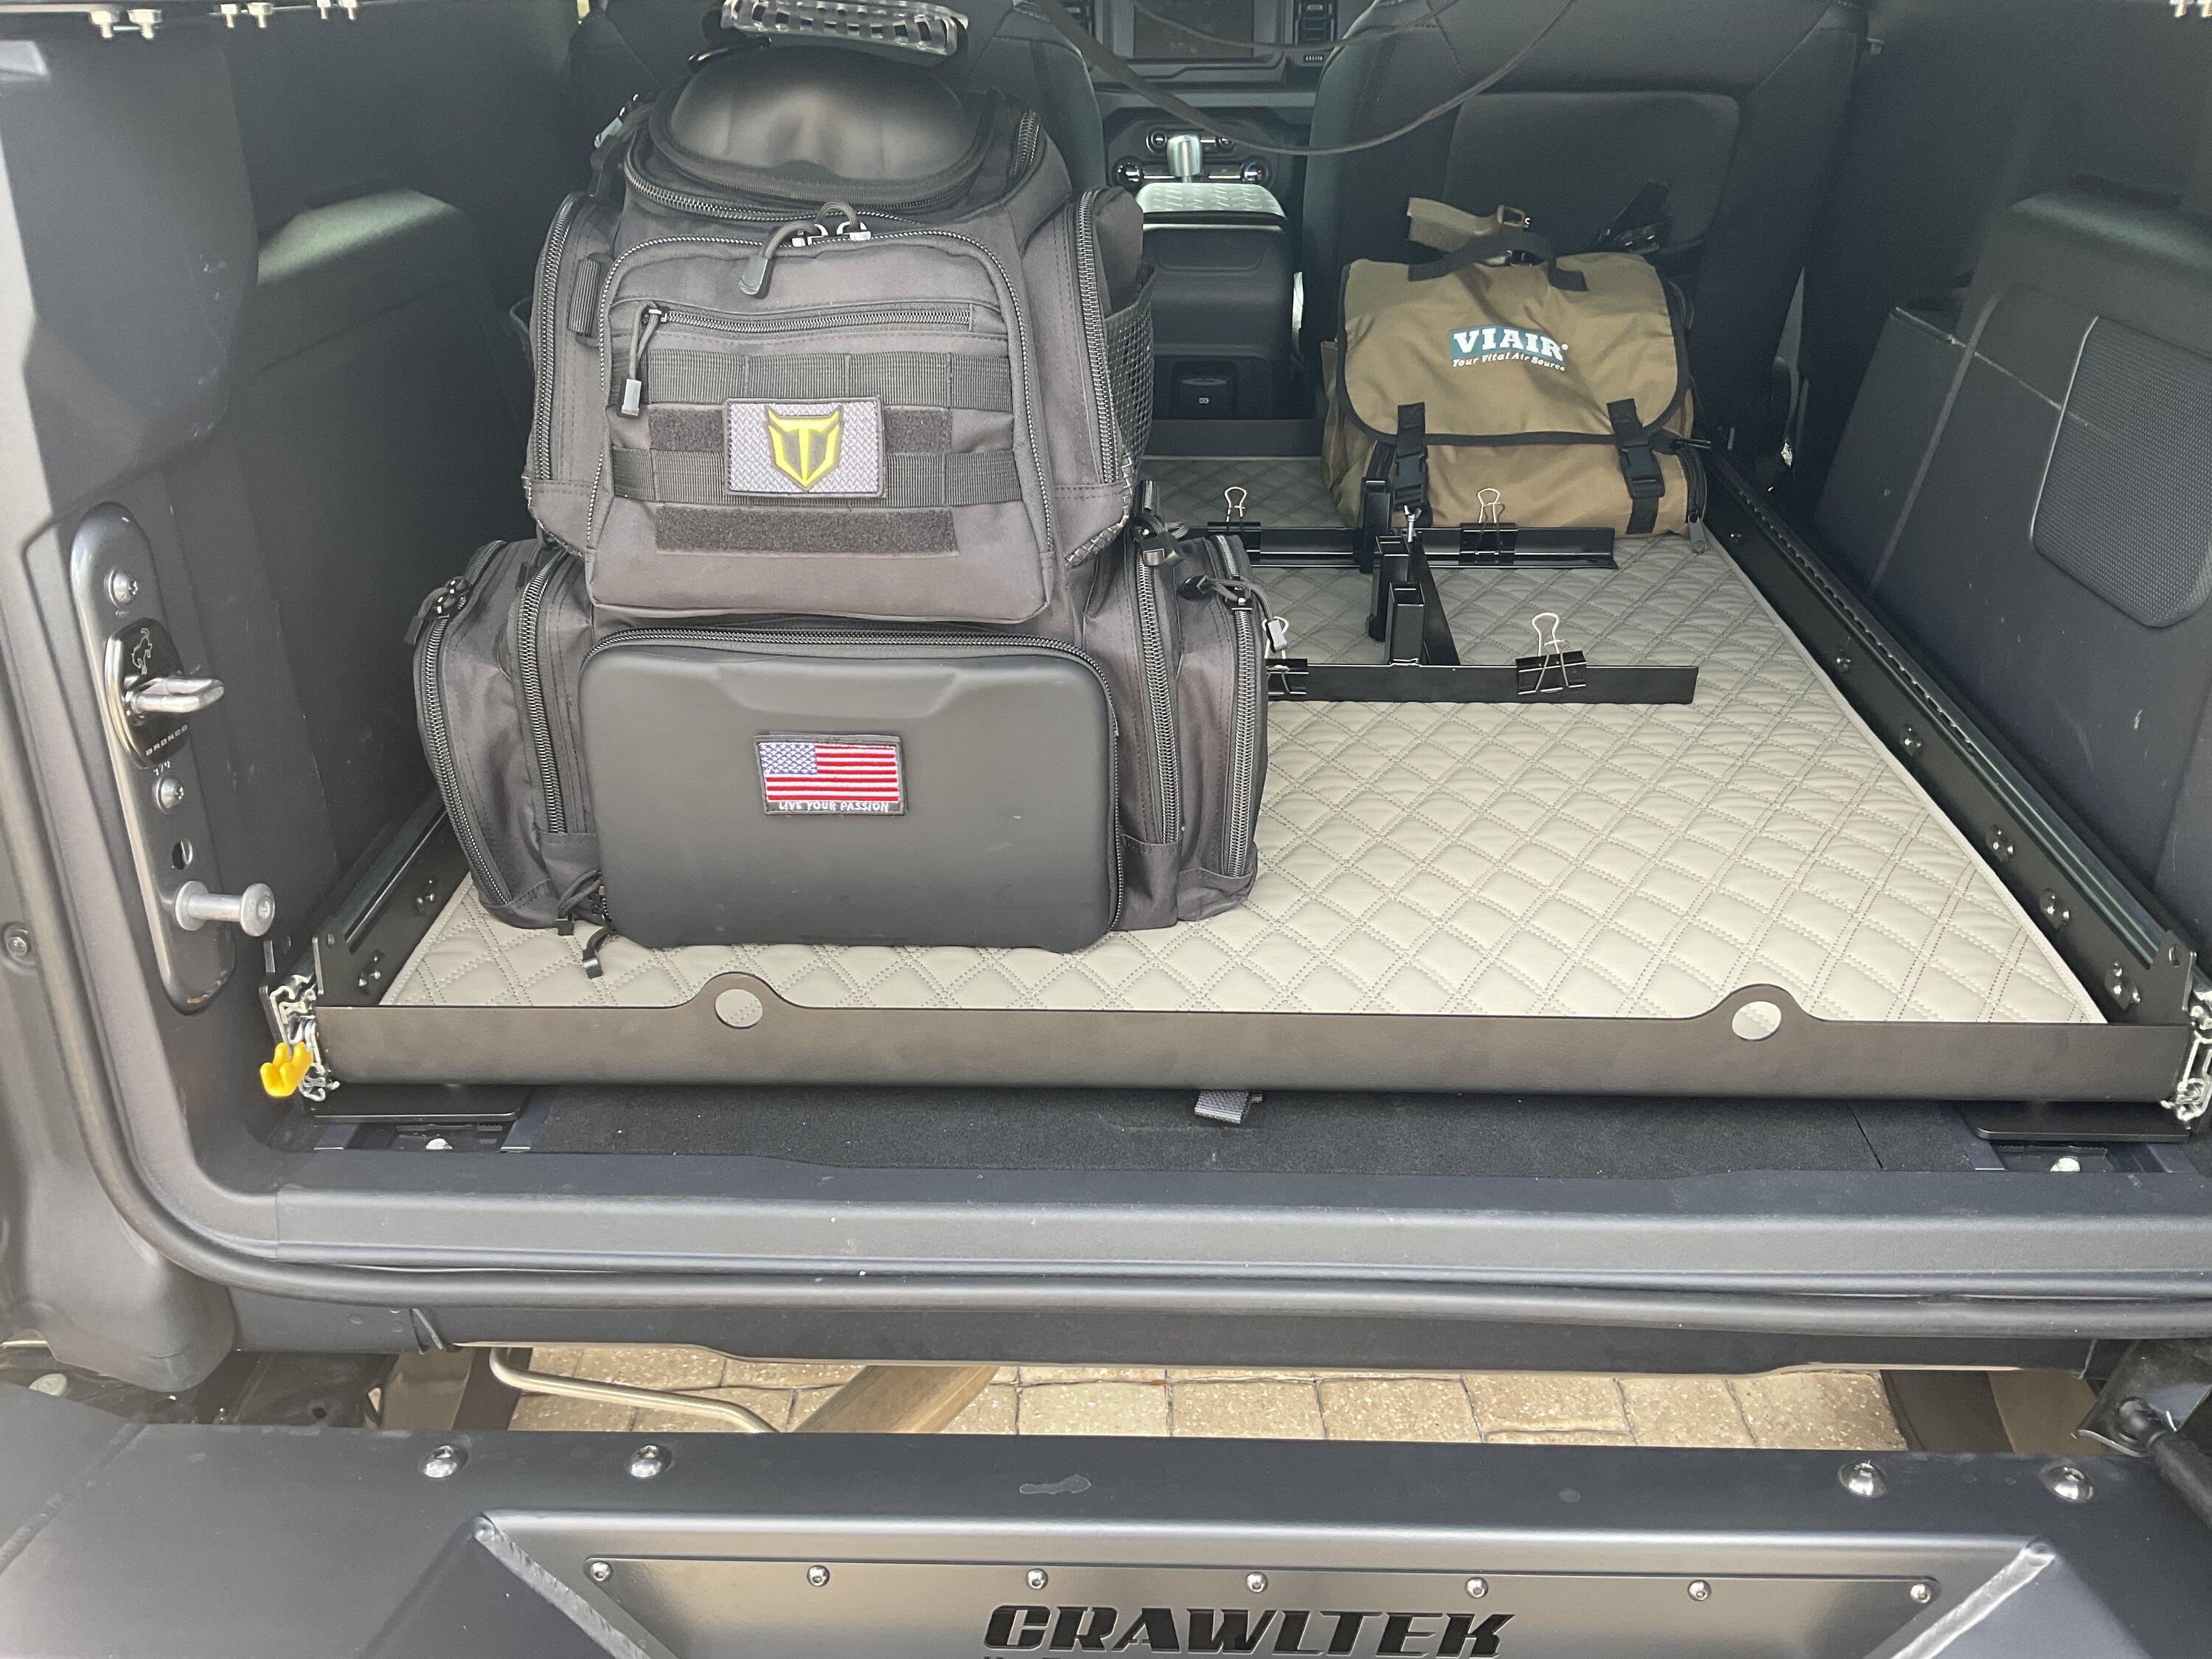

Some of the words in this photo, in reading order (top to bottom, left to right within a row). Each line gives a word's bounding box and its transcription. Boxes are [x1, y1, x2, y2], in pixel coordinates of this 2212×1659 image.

[1452, 358, 1479, 367] Your
[1481, 352, 1510, 363] Vital
[1512, 352, 1530, 361] Air
[1531, 357, 1565, 372] Source
[145, 724, 188, 757] BRONCO
[779, 801, 802, 811] LIVE
[807, 801, 836, 811] YOUR
[840, 801, 889, 813] PASSION
[984, 1604, 1515, 1658] CRAWLTEK
